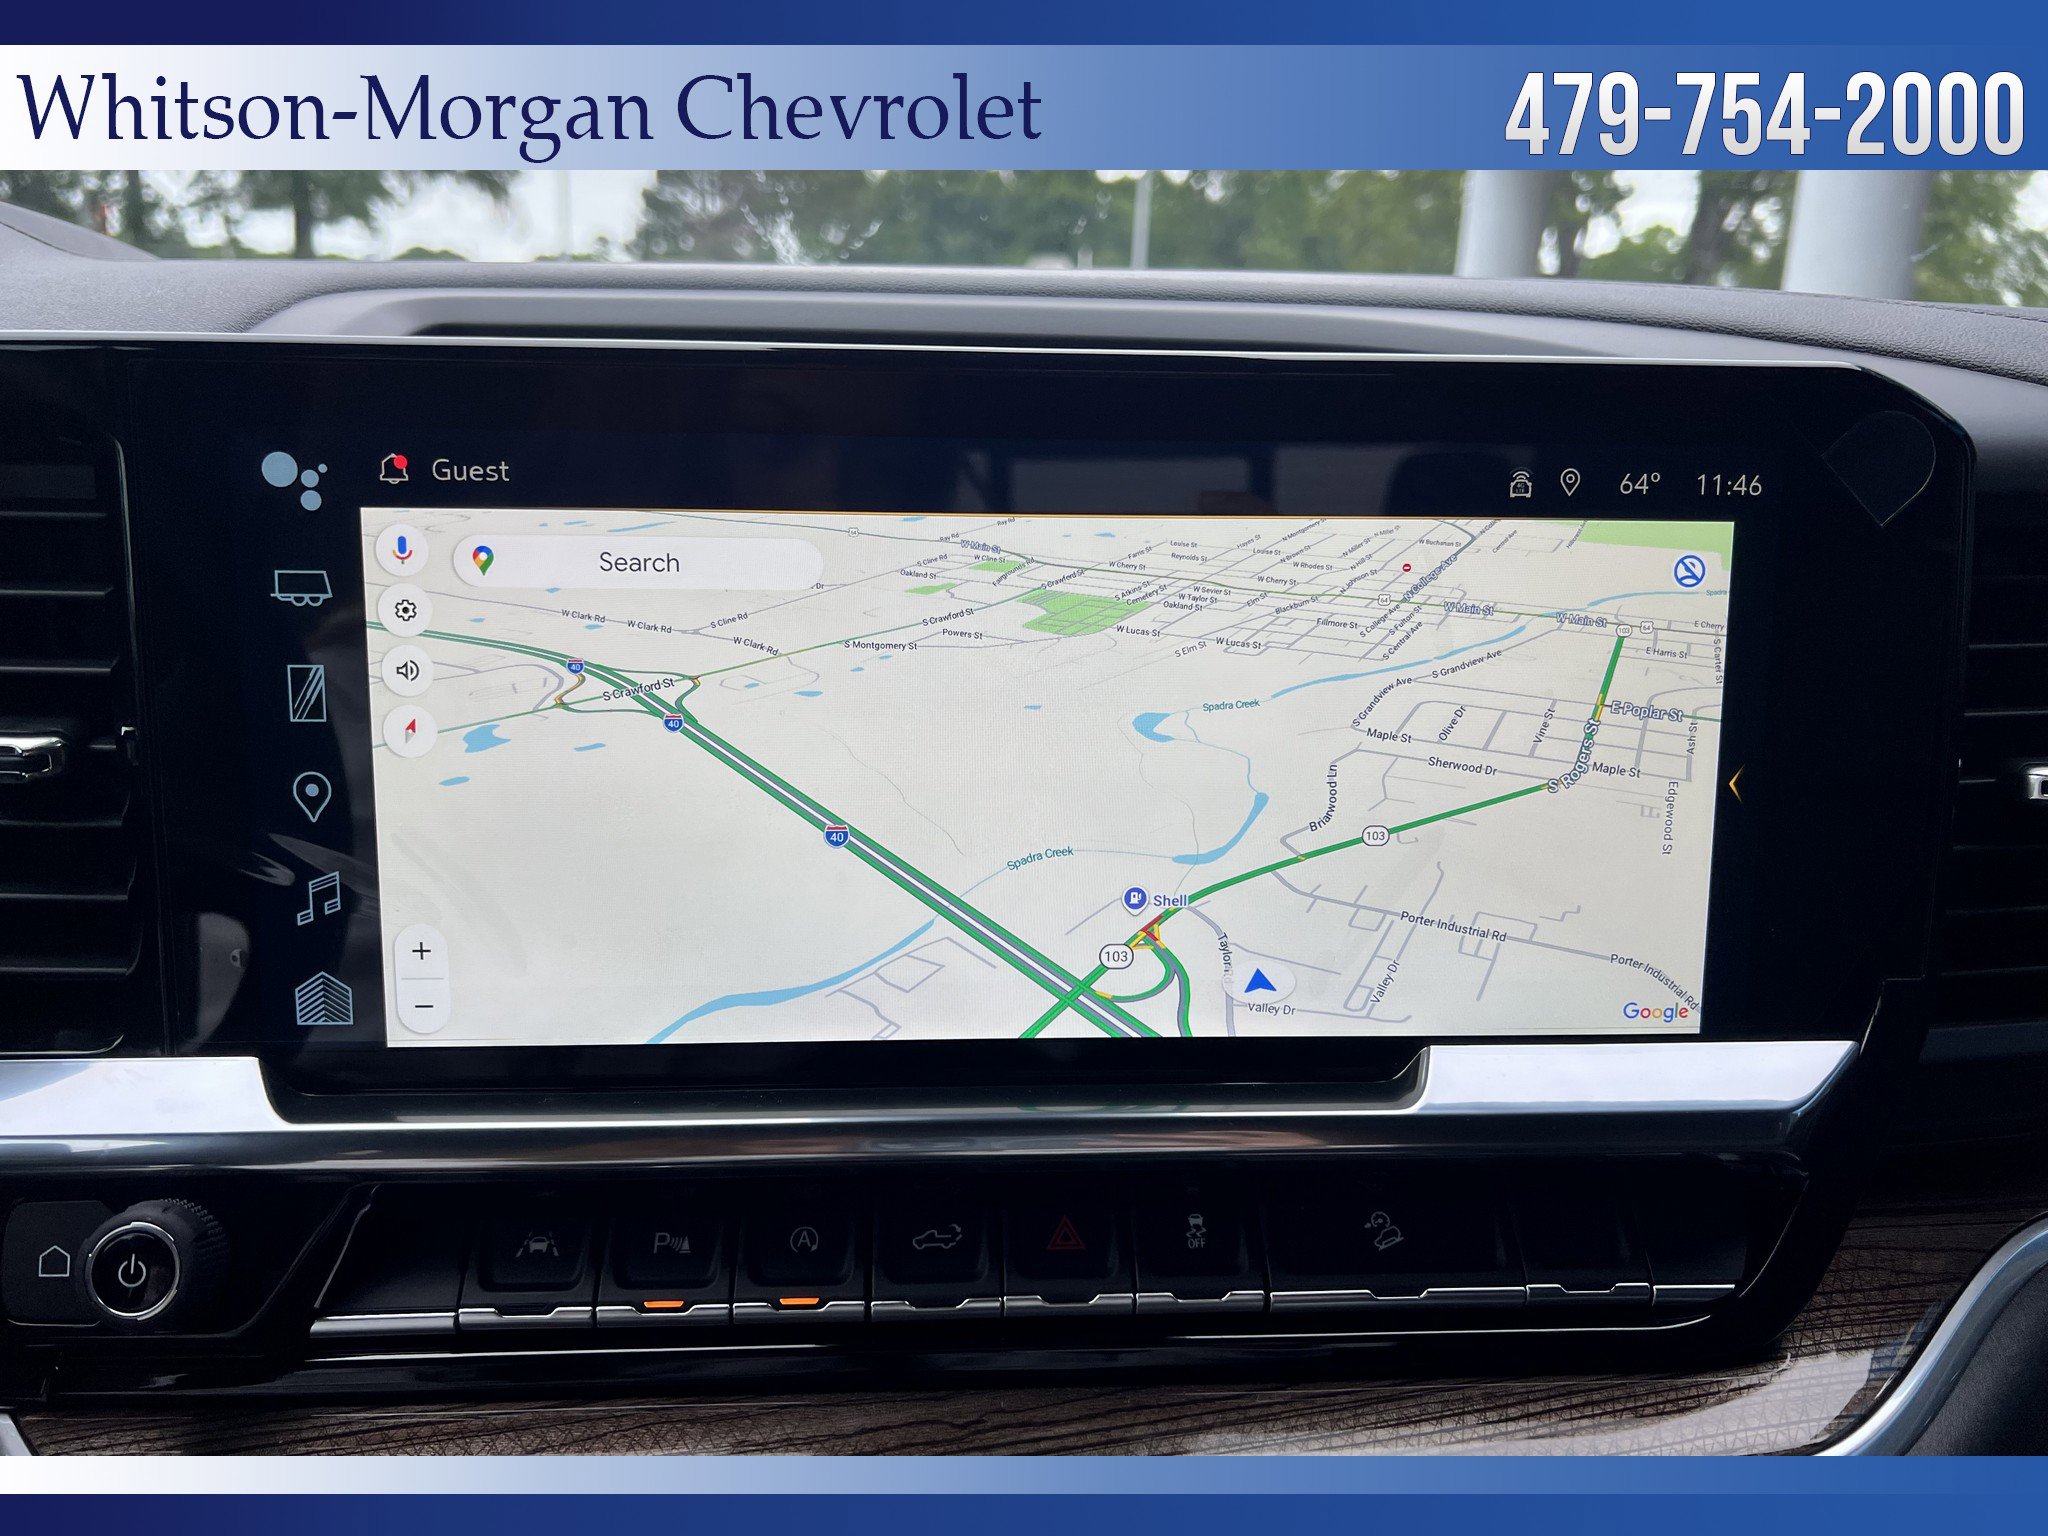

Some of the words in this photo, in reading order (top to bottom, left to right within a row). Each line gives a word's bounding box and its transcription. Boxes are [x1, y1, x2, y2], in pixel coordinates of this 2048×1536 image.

[432, 458, 510, 481] Guest
[1698, 474, 1762, 496] 11:46
[600, 552, 680, 573] Search
[1118, 561, 1137, 571] Cherry
[1300, 562, 1324, 570] Rhodes
[900, 569, 928, 579] Oakland
[930, 572, 937, 580] St
[1267, 575, 1288, 586] Cherry
[1289, 578, 1297, 586] St
[1121, 584, 1141, 598] Atkins
[1142, 581, 1151, 589] St
[1126, 588, 1158, 606] Cemetery
[1158, 584, 1167, 592] St
[1202, 586, 1222, 594] Sevier
[1163, 600, 1193, 610] Oakland
[1187, 594, 1208, 603] Taylor
[1210, 596, 1217, 604] St
[1246, 596, 1259, 607] Elm
[1259, 591, 1269, 600] St
[1275, 600, 1310, 615] Blackburn
[1444, 601, 1455, 611] W
[1456, 602, 1480, 614] Main
[1482, 605, 1494, 616] St
[561, 609, 570, 617] W
[571, 610, 593, 621] Clark
[594, 614, 606, 623] Rd
[710, 621, 717, 629] S
[717, 616, 737, 627] Cline
[737, 612, 749, 621] Rd
[930, 610, 964, 625] Crawford
[965, 608, 974, 616] St
[1316, 618, 1347, 629] Fillmore
[1350, 621, 1358, 629] St
[1359, 630, 1366, 638] S
[1366, 613, 1388, 634] College
[1388, 604, 1400, 616] Ave
[1388, 628, 1396, 636] S
[1394, 613, 1414, 631] Fulton
[1414, 605, 1422, 613] St
[1556, 612, 1566, 622] W
[1568, 615, 1594, 626] Main
[1595, 617, 1607, 628] St
[627, 620, 636, 628] W
[637, 621, 659, 632] Clark
[660, 625, 672, 634] Rd
[1126, 625, 1150, 636] Lucas
[1152, 629, 1161, 637] St
[1618, 626, 1630, 634] 103
[1701, 621, 1725, 630] Cherry
[942, 628, 972, 639] Powers
[973, 631, 983, 640] St
[1388, 634, 1410, 655] Central
[1410, 620, 1423, 634] Ave
[733, 636, 743, 645] W
[744, 638, 765, 650] Clark
[766, 645, 779, 656] Rd
[852, 641, 906, 651] Montgomery
[908, 642, 917, 650] St
[1174, 650, 1181, 658] S
[1182, 644, 1198, 656] Elm
[1199, 641, 1207, 649] St
[1215, 637, 1225, 645] W
[1226, 638, 1251, 648] Lucas
[1252, 641, 1262, 649] St
[1653, 648, 1677, 658] Harris
[1678, 650, 1688, 659] St
[1714, 647, 1722, 673] Carter
[570, 663, 580, 671] 40
[1432, 671, 1439, 679] S
[1440, 657, 1485, 677] Grandview
[1486, 649, 1502, 660] Ave
[1715, 675, 1723, 684] St
[602, 691, 611, 701] S
[612, 682, 661, 699] Crawford
[662, 677, 675, 688] St
[1202, 702, 1234, 713] Spadra
[1235, 699, 1261, 709] Creek
[1352, 718, 1361, 728] S
[1358, 684, 1395, 721] Grandview
[1395, 676, 1413, 687] Ave
[1610, 701, 1621, 714] E
[1622, 703, 1665, 720] Poplar
[1667, 709, 1684, 722] St
[668, 720, 680, 728] 40
[1438, 718, 1459, 742] Olive
[1455, 705, 1467, 718] Dr
[1532, 719, 1550, 744] Vine
[1543, 707, 1556, 720] St
[1688, 722, 1698, 734] St
[1366, 728, 1398, 742] Maple
[1400, 733, 1412, 744] St
[1686, 735, 1697, 755] Ash
[1547, 779, 1559, 793] S
[1560, 738, 1594, 789] Rogers
[1583, 717, 1601, 735] St
[1427, 756, 1482, 774] Sherwood
[1484, 765, 1498, 776] Dr
[1592, 762, 1627, 776] Maple
[1628, 767, 1641, 778] St
[1308, 781, 1337, 832] Briarwood
[1326, 764, 1337, 778] Ln
[1663, 781, 1679, 841] Edgewood
[830, 832, 844, 842] 40
[1366, 831, 1385, 841] 103
[1662, 844, 1673, 855] St
[1006, 852, 1043, 871] Spadra
[1045, 846, 1074, 859] Creek
[1153, 895, 1187, 907] Shell
[1400, 911, 1435, 927] Porter
[1436, 919, 1490, 939] Industrial
[1491, 930, 1507, 942] Rd
[1104, 951, 1128, 963] 103
[1218, 932, 1232, 967] Taylor
[1370, 974, 1395, 1005] Valley
[1386, 960, 1400, 974] Dr
[1610, 953, 1644, 969] Porter
[1643, 963, 1688, 999] Industrial
[1684, 995, 1700, 1011] Rd
[1248, 1003, 1280, 1016] Valley
[1283, 1004, 1296, 1015] Dr
[1623, 1001, 1689, 1023] Google
[1188, 1238, 1206, 1249] OFF
